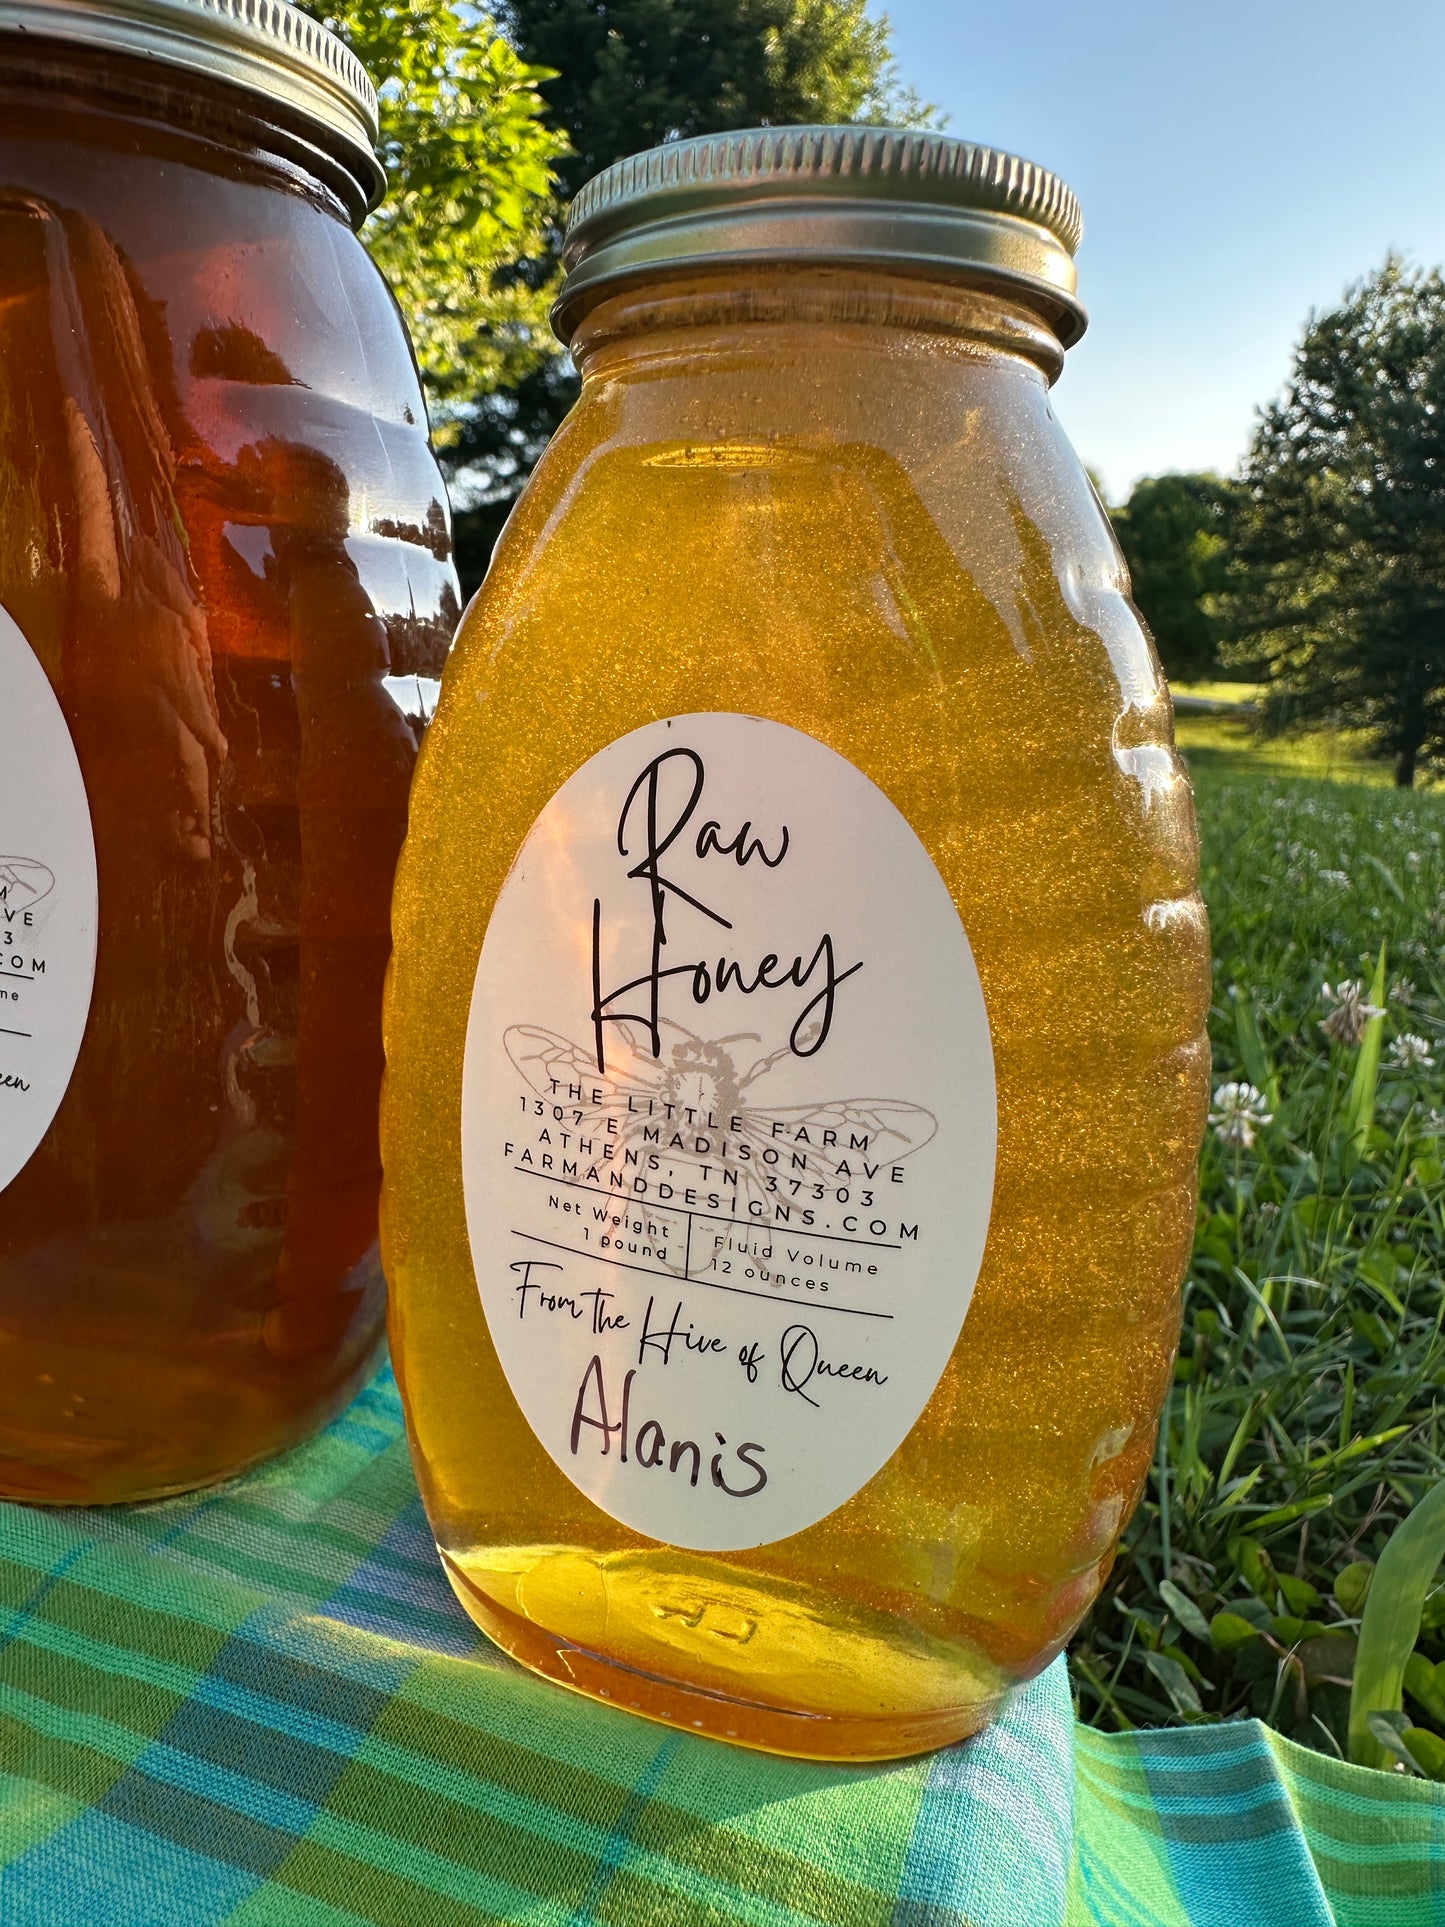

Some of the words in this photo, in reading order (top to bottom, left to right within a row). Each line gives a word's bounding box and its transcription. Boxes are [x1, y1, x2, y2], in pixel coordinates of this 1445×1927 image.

[618, 747, 790, 945] Raw
[591, 889, 864, 1074] Honey
[520, 1096, 583, 1126] 1307
[607, 1118, 618, 1134] E
[643, 1126, 807, 1170] MADISON
[835, 1159, 905, 1183] AVE
[550, 1078, 603, 1105] THE
[628, 1096, 743, 1132] LITTLE
[771, 1122, 869, 1151] FARM
[504, 1142, 919, 1241] FARMANDDESIGNS.COM
[538, 1128, 673, 1176] ATHENS,
[699, 1164, 738, 1186] TN
[765, 1175, 874, 1207] 37303
[549, 1195, 581, 1215] Net
[593, 1207, 669, 1238] Weight
[583, 1227, 589, 1240] 1
[601, 1235, 667, 1260] pound
[714, 1236, 773, 1259] Fluid
[787, 1249, 878, 1275] Volume
[711, 1258, 732, 1274] 12
[744, 1268, 829, 1292] ounces
[509, 1261, 583, 1319] From
[638, 1296, 727, 1365] Hive
[738, 1342, 765, 1383] of
[780, 1324, 888, 1407] Queen
[570, 1354, 768, 1498] Alanis
